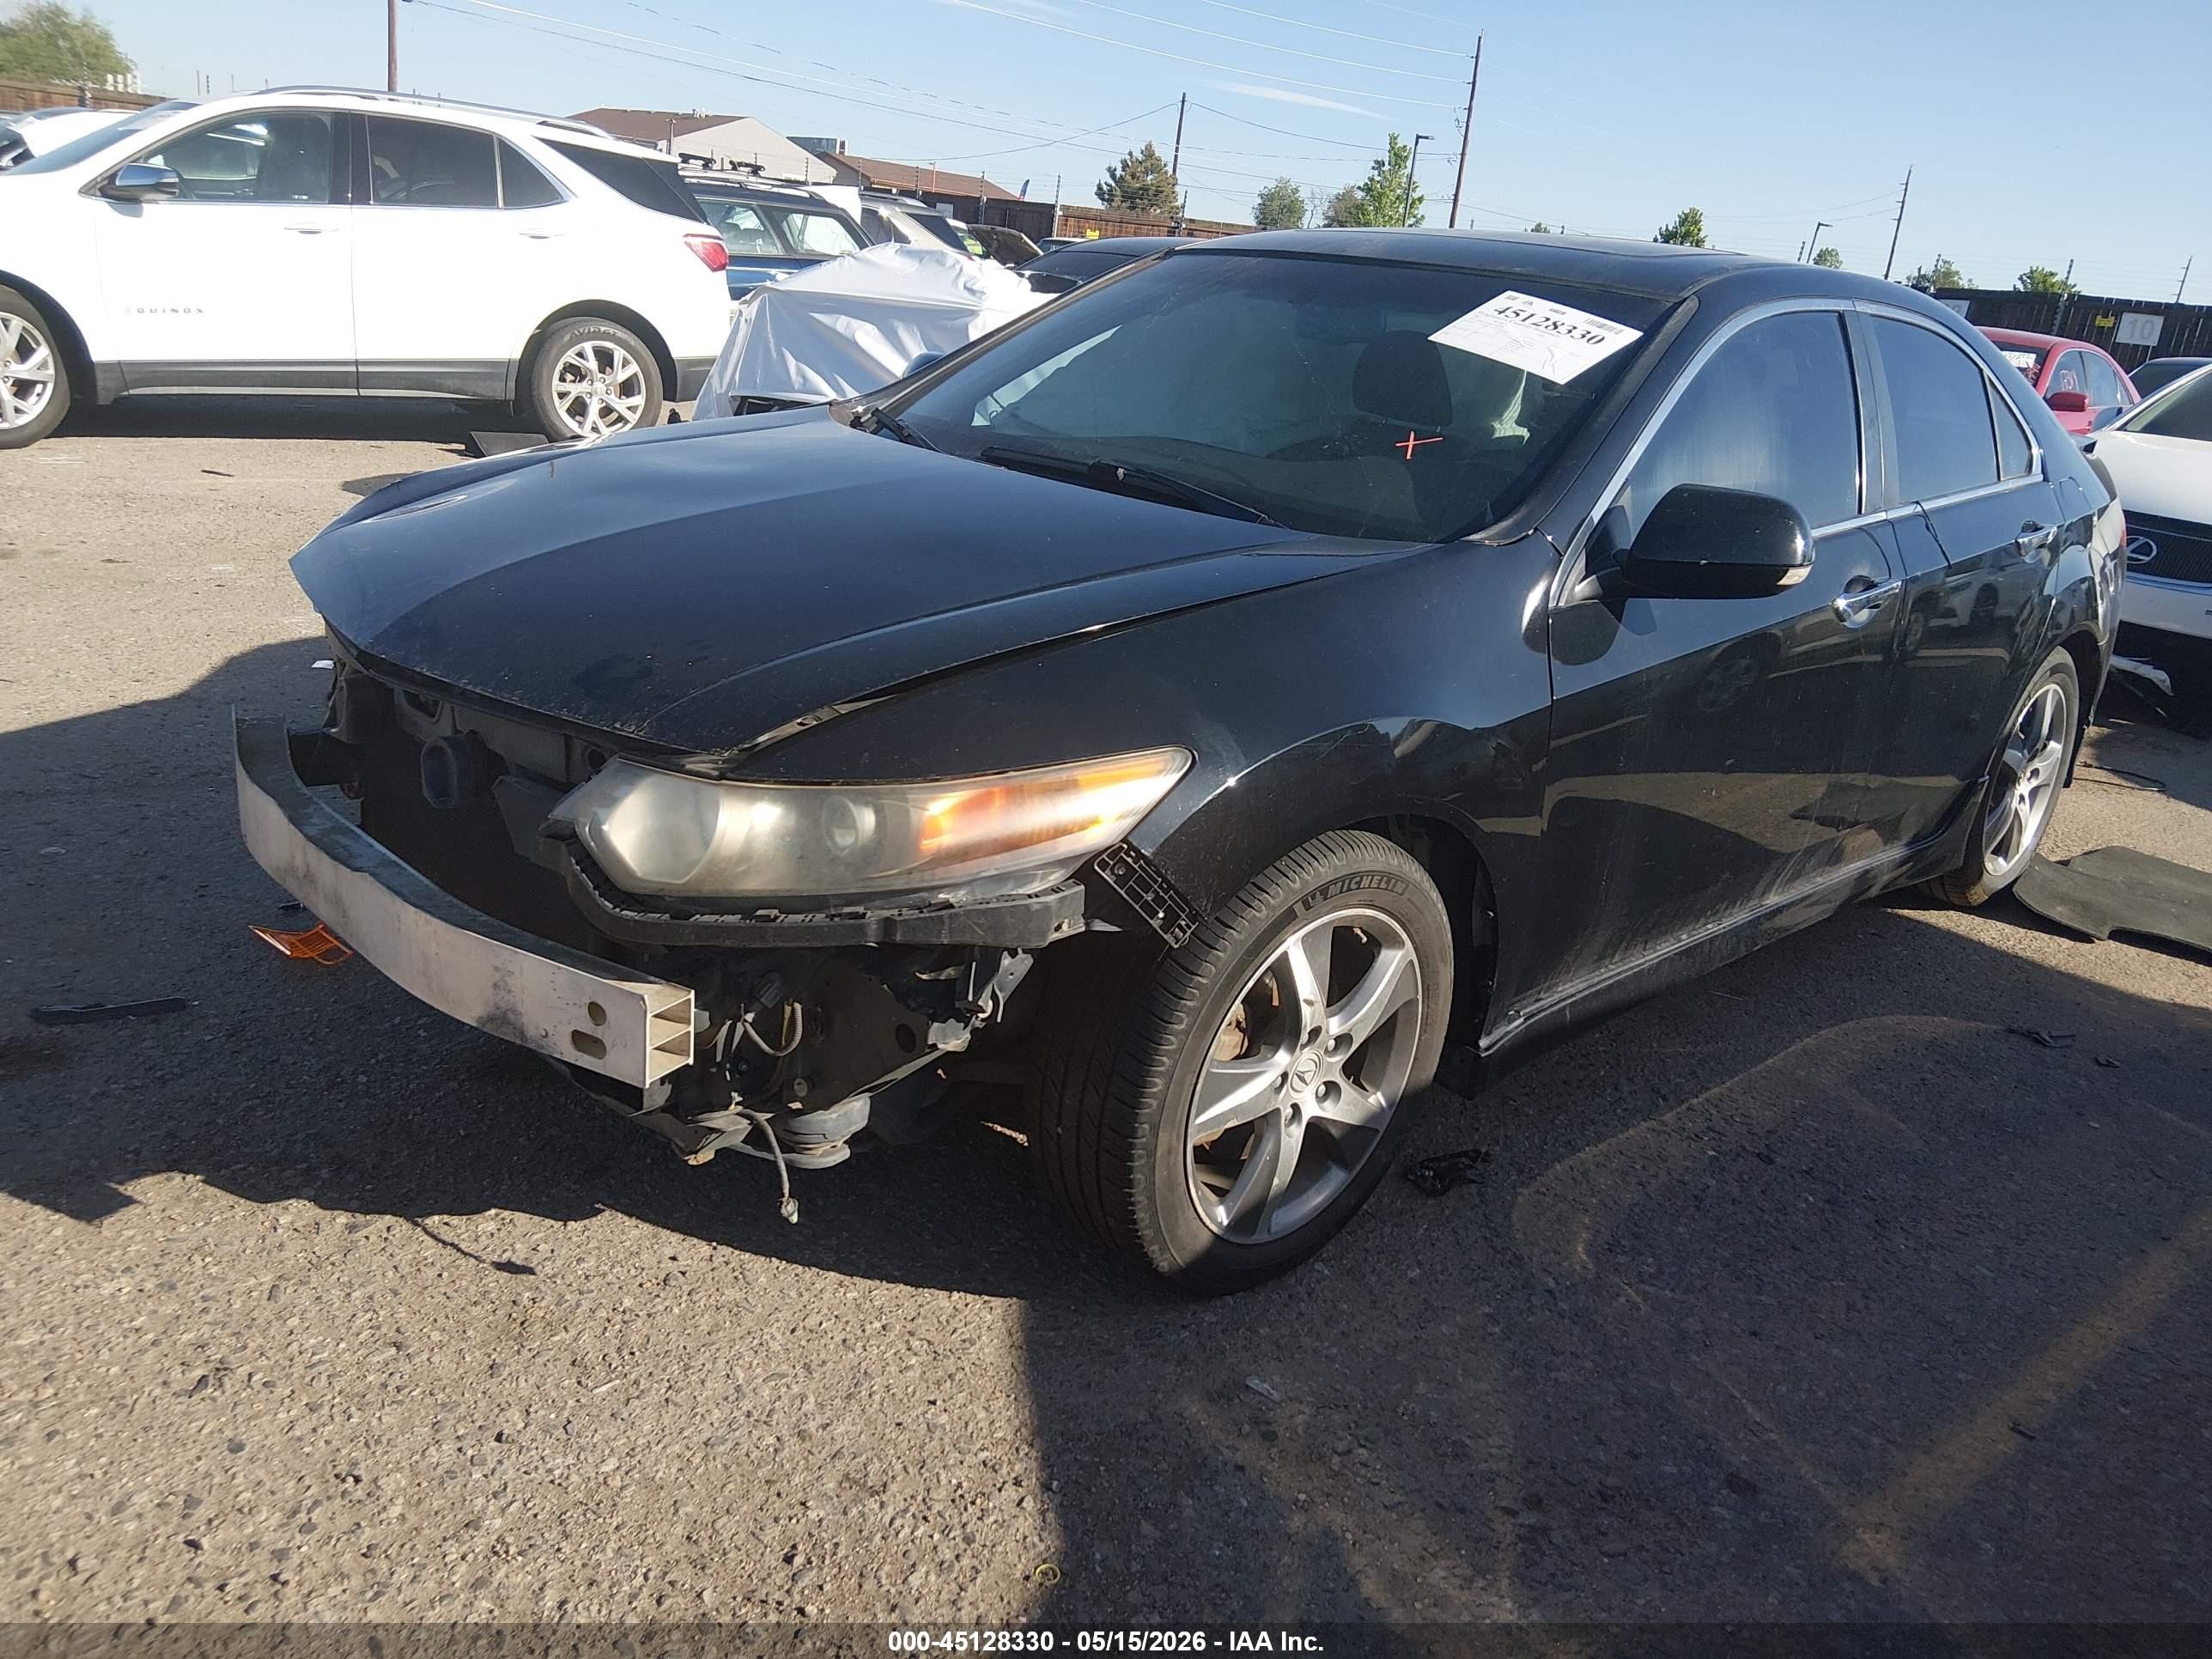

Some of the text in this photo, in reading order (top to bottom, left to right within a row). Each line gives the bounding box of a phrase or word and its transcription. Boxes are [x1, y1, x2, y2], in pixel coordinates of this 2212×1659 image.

[1493, 306, 1606, 344] 45128330
[2128, 318, 2155, 339] 10
[1327, 874, 1406, 899] MICHELIN
